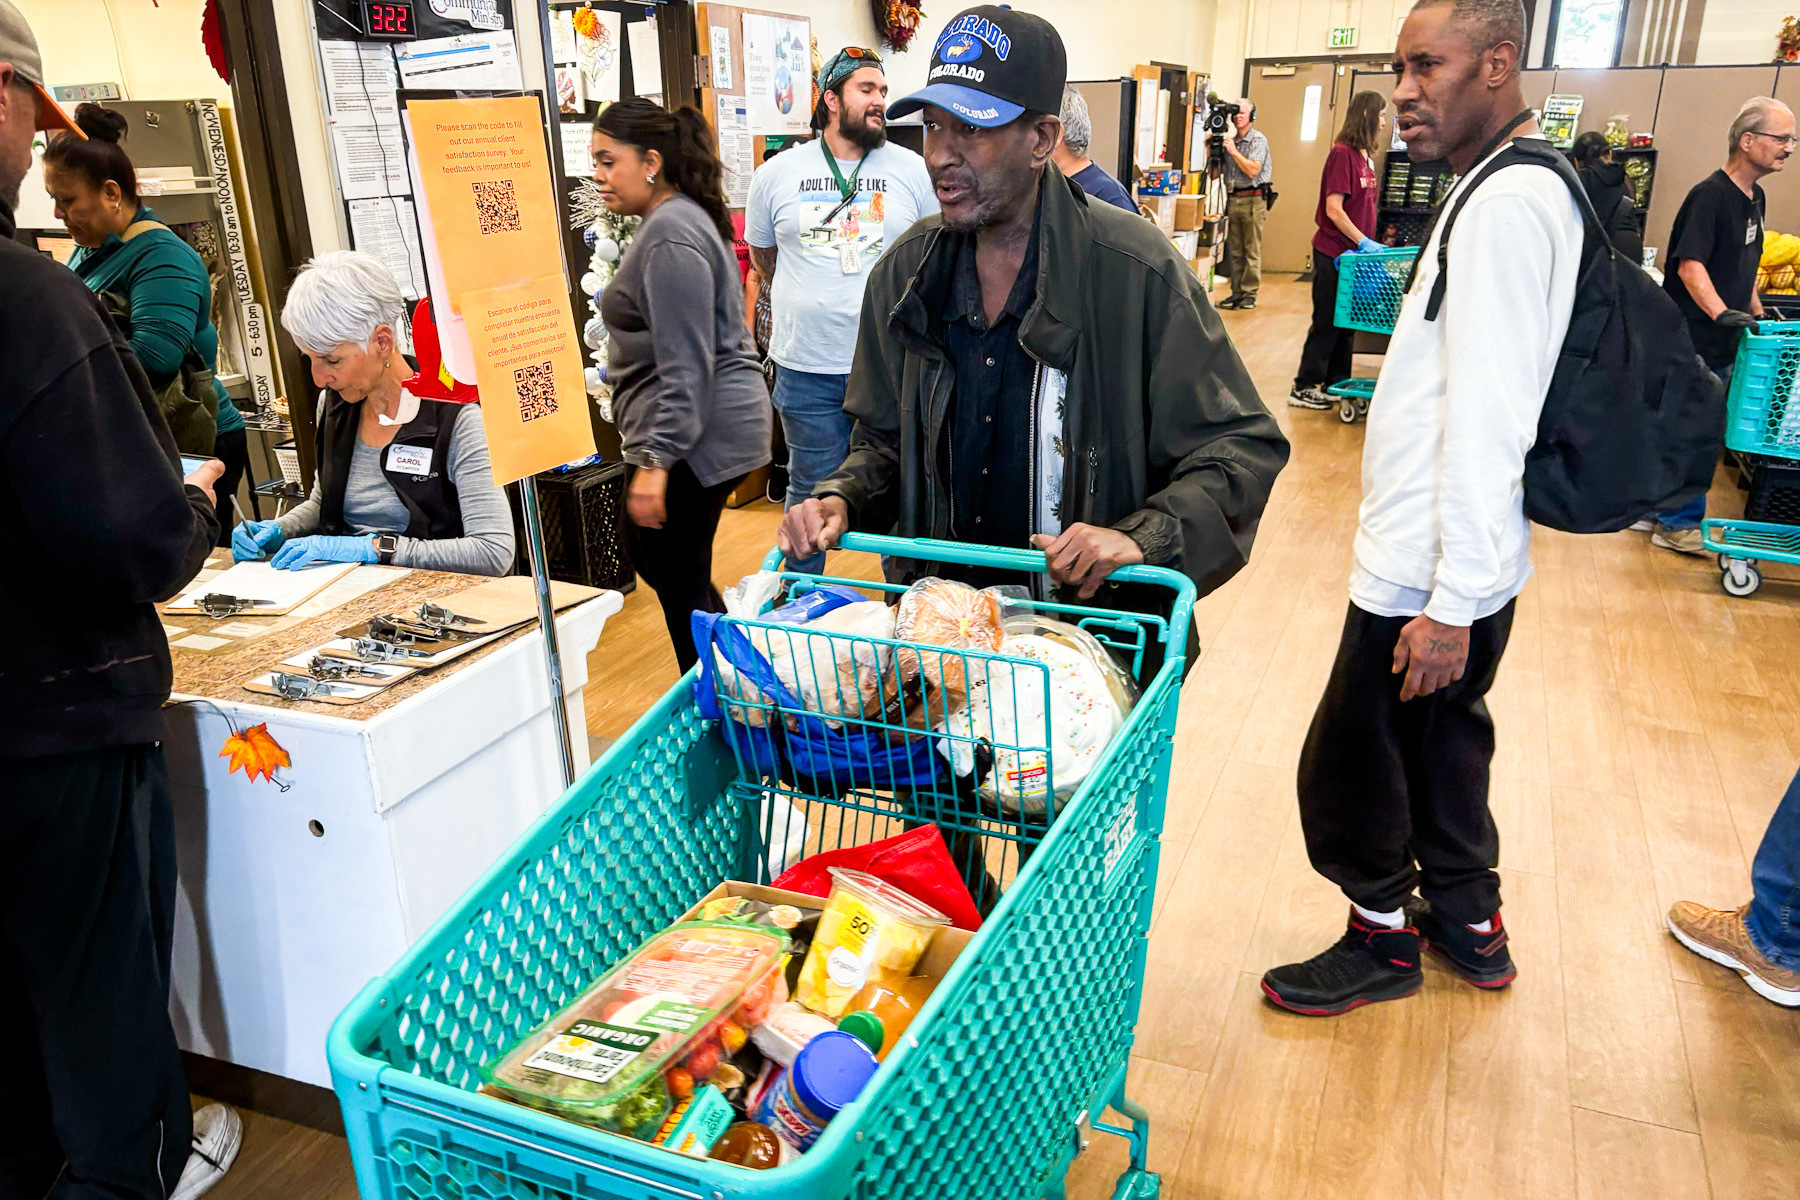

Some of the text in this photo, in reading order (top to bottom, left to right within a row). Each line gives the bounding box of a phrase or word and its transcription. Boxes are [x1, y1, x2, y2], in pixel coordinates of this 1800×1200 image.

[372, 5, 407, 32] 322
[1332, 27, 1356, 46] EXIT
[929, 63, 985, 82] COLORADO
[952, 102, 999, 120] COLORADO
[436, 120, 523, 132] Please scan the code to fill
[449, 134, 516, 146] out our annual client
[445, 147, 524, 160] satisfaction survey. Your
[442, 160, 532, 174] feedback is important to us!
[798, 177, 841, 192] ADULTIN
[866, 177, 887, 193] LIKE
[214, 172, 252, 304] TUESDAY 10:30 am to NOON
[248, 305, 260, 320] pm
[487, 298, 552, 318] Escanee el código para
[483, 308, 561, 332] completar nuestra encuesta
[491, 320, 559, 343] anual de satisfacción del
[251, 346, 263, 358] 5
[487, 347, 510, 358] cliente.
[522, 335, 557, 348] comentarios
[556, 331, 567, 340] son
[493, 343, 566, 369] importantes para nosotros!
[396, 456, 422, 466] CAROL
[1010, 769, 1043, 780] REUCED
[831, 957, 860, 974] Organic
[570, 1023, 651, 1047] ORGANIC
[531, 1050, 614, 1078] Earthbound
[592, 1047, 631, 1066] Farm
